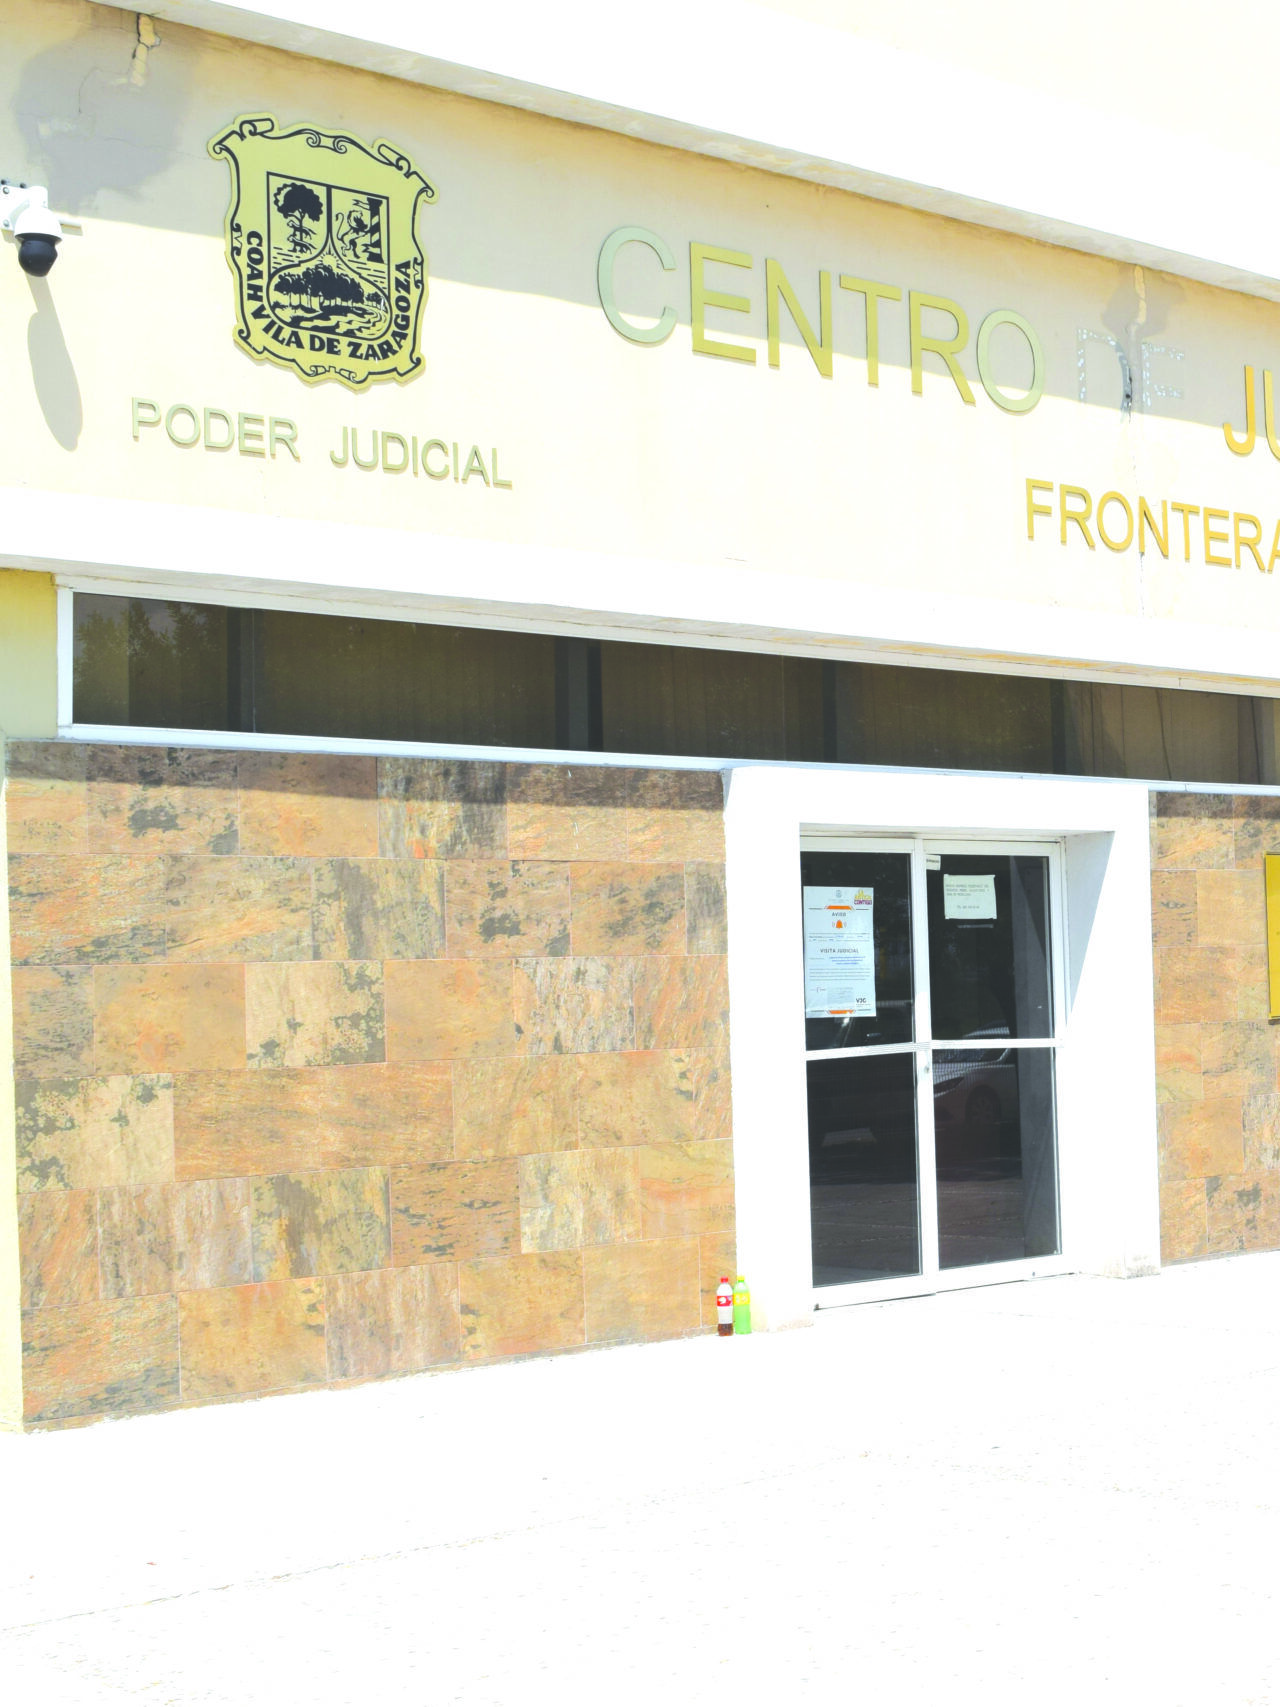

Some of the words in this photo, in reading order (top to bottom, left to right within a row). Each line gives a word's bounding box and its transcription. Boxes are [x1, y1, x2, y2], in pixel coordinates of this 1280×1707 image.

[309, 334, 341, 355] DE
[347, 260, 411, 361] ZARAGOZA
[597, 226, 1046, 414] CENTRO
[1077, 327, 1185, 424] DE
[131, 397, 301, 461] PODER
[330, 426, 513, 490] JUDICIAL
